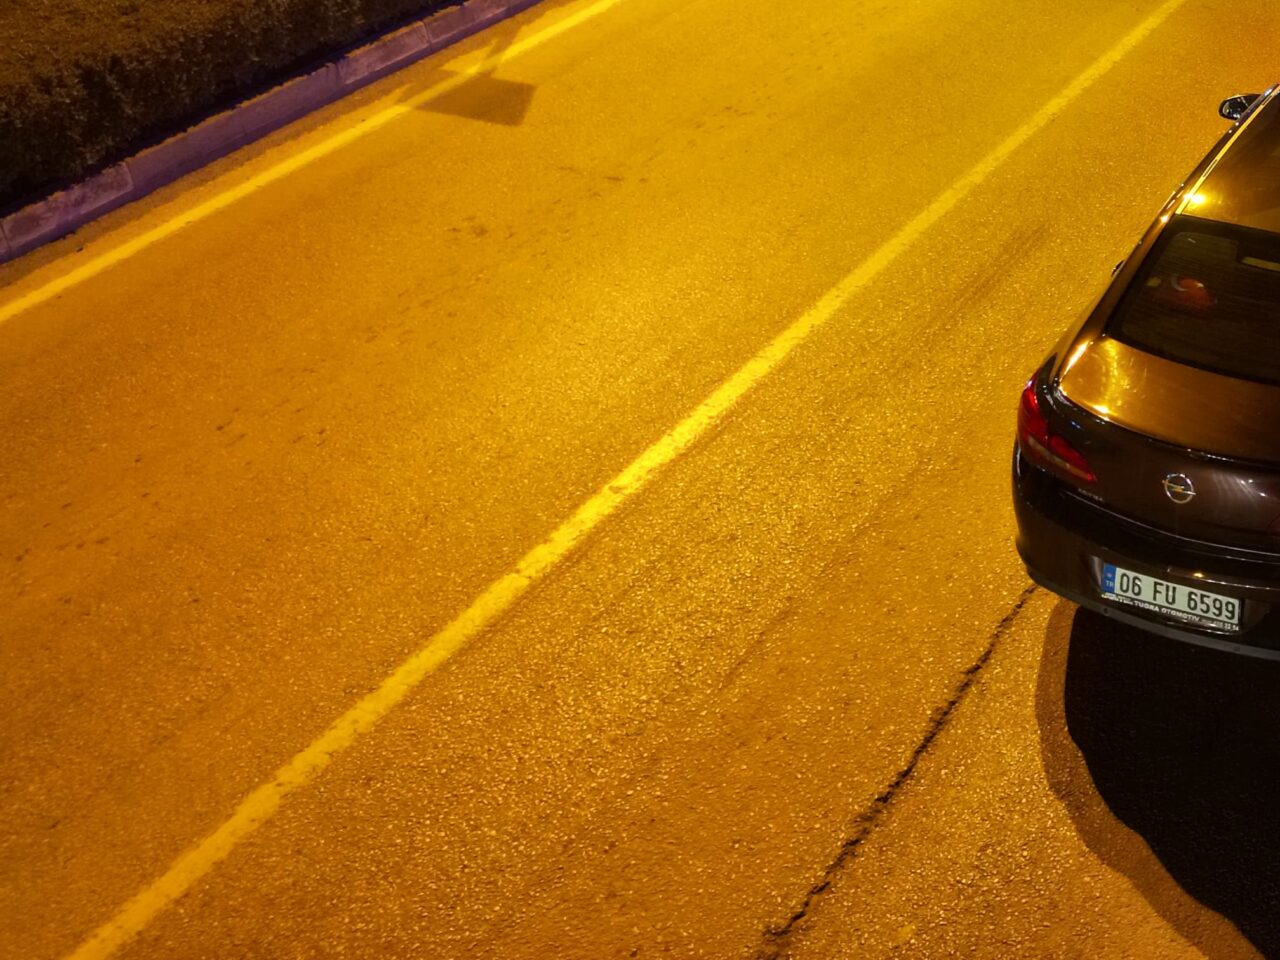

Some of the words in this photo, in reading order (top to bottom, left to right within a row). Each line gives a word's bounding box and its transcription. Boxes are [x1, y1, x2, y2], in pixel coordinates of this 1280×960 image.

[1106, 580, 1114, 588] TR
[1119, 573, 1142, 596] 06
[1152, 581, 1177, 605] FU
[1187, 591, 1236, 620] 6599
